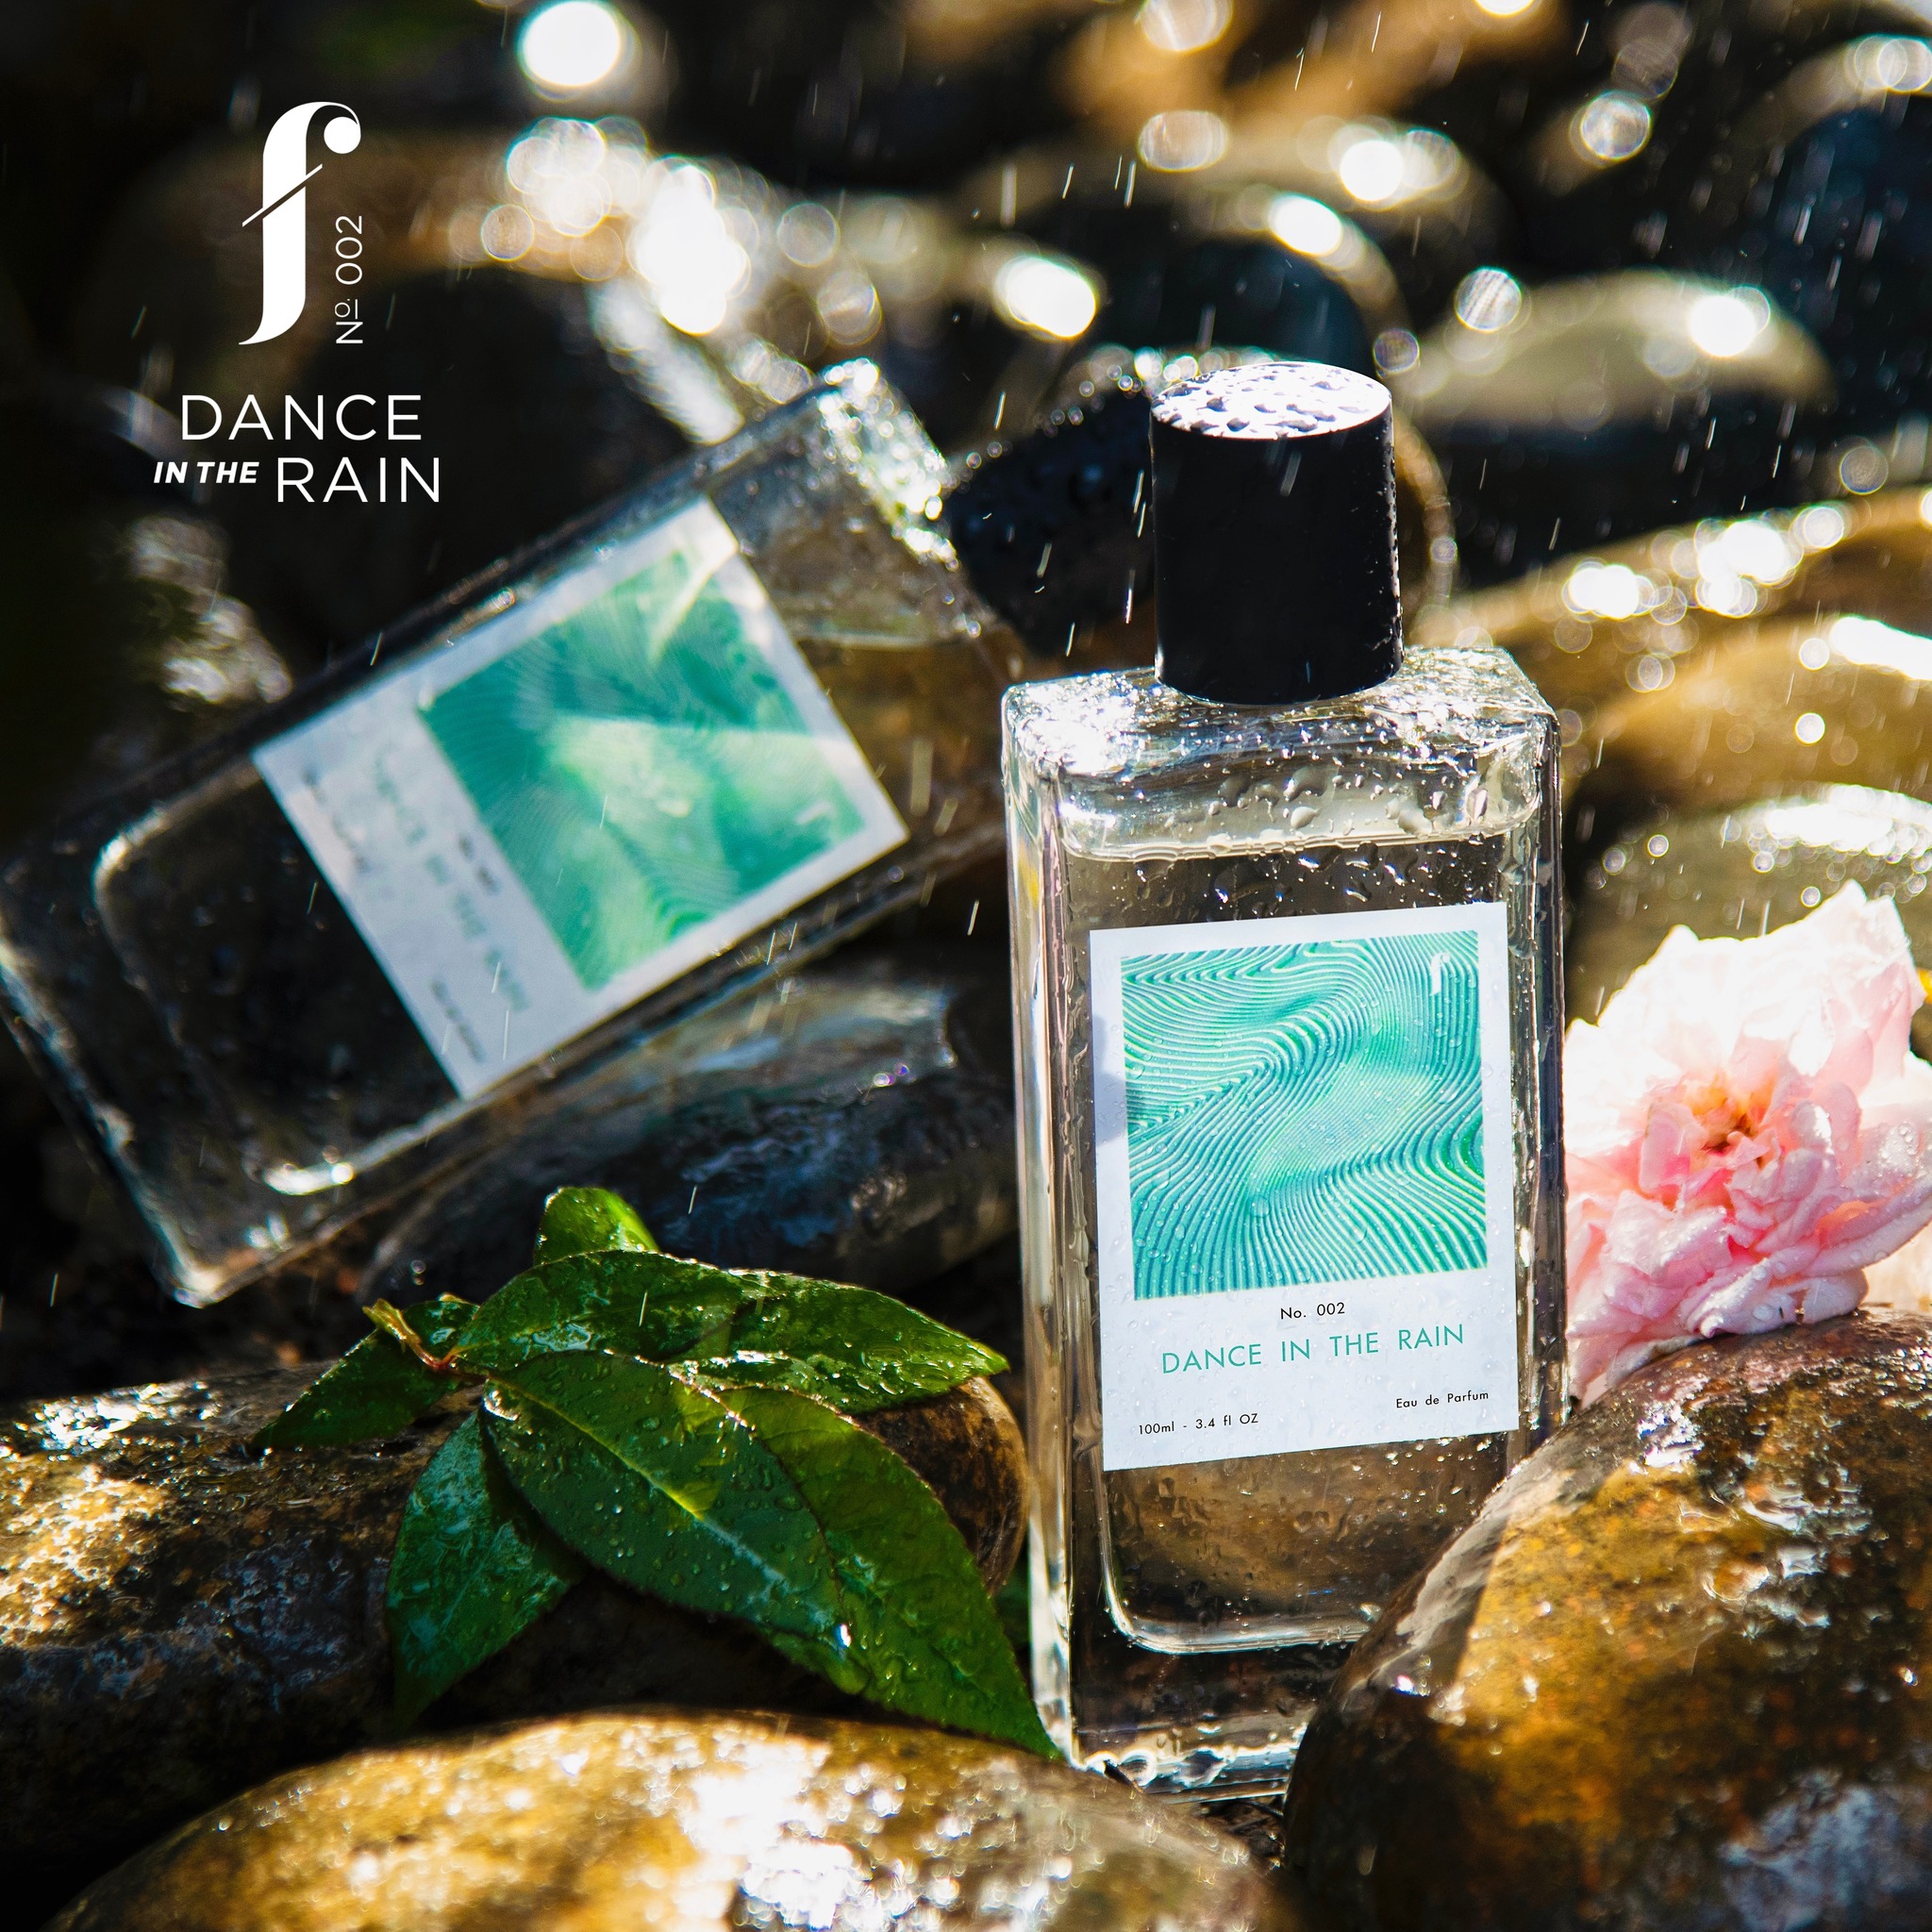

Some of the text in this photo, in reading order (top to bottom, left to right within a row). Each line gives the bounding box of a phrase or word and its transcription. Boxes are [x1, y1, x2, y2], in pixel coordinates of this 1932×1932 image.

[1280, 1301, 1345, 1320] No. 002
[1161, 1324, 1464, 1374] DANCE IN THE RAIN
[1395, 1390, 1490, 1409] Eau de Parfum
[1139, 1421, 1175, 1435] 100ml
[1195, 1418, 1216, 1430] 3.4
[1223, 1414, 1232, 1426] fl
[1240, 1412, 1258, 1424] OZ
